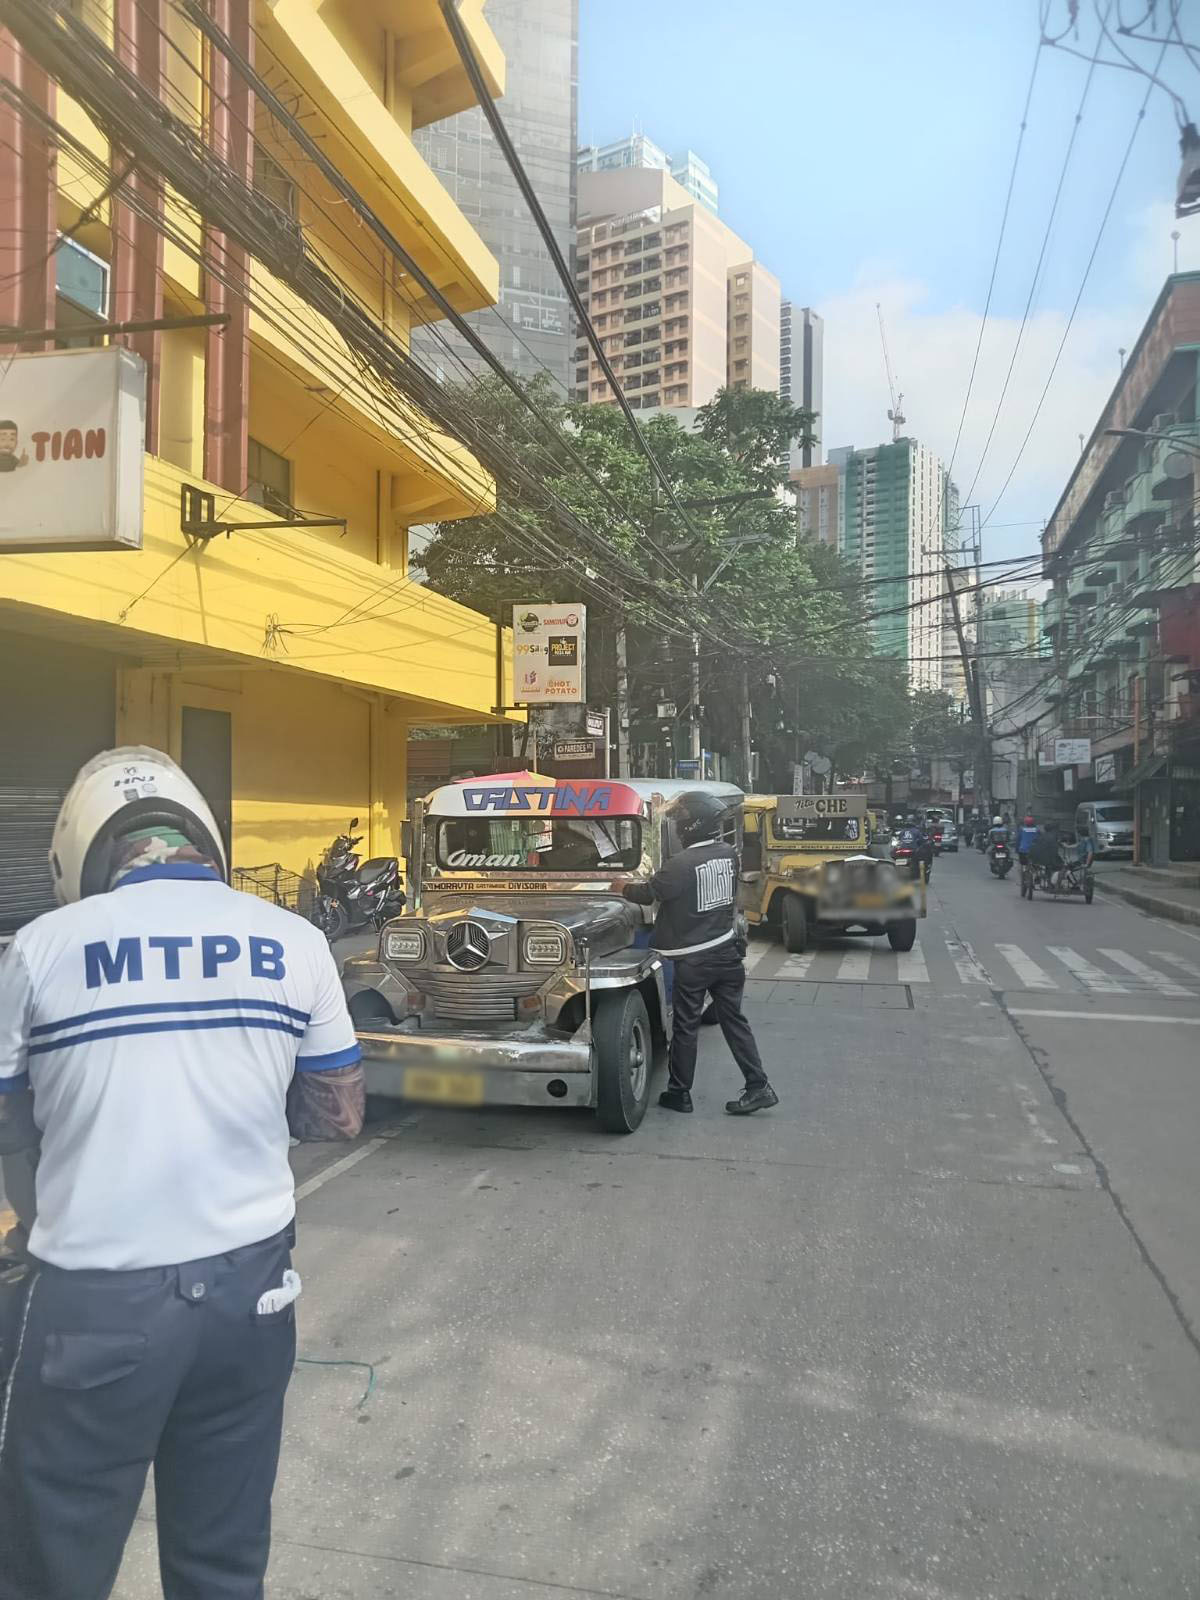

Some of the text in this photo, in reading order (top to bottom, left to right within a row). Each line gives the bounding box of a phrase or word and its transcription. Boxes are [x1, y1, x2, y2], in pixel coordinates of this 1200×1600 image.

[31, 427, 107, 463] TIAN
[564, 743, 587, 753] PAREDES
[815, 798, 847, 813] CHE
[447, 849, 521, 867] Oman
[84, 935, 286, 990] MTPB
